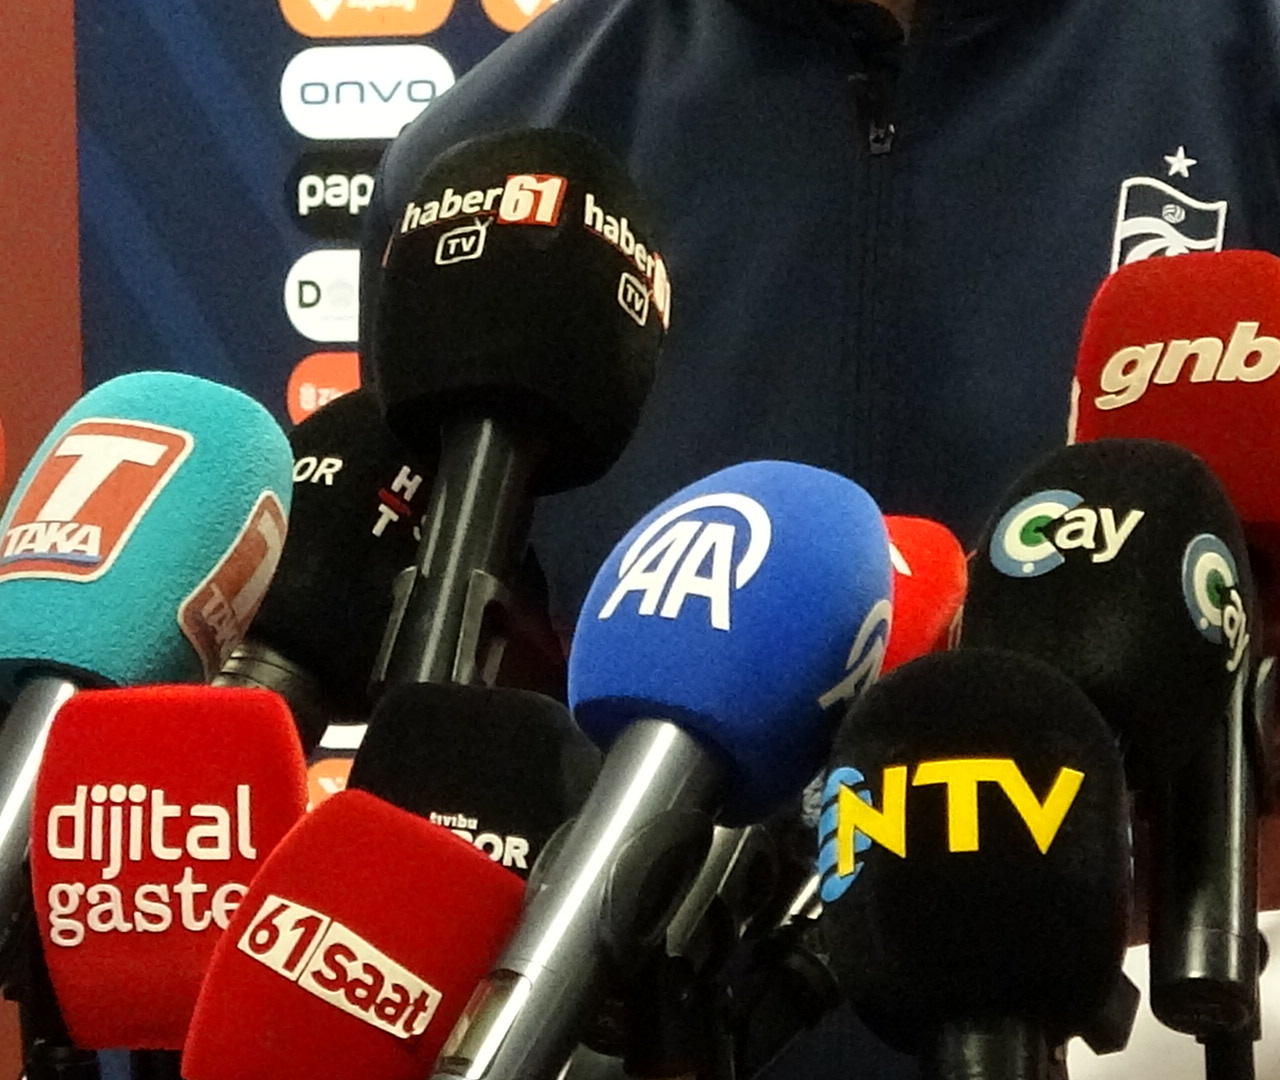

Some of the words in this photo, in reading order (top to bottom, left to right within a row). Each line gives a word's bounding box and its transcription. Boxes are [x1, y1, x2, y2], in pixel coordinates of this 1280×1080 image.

[300, 80, 436, 105] onvo
[447, 236, 477, 256] TV
[3, 522, 102, 557] TAKA
[47, 783, 257, 880] dijital
[837, 759, 1086, 878] NTV
